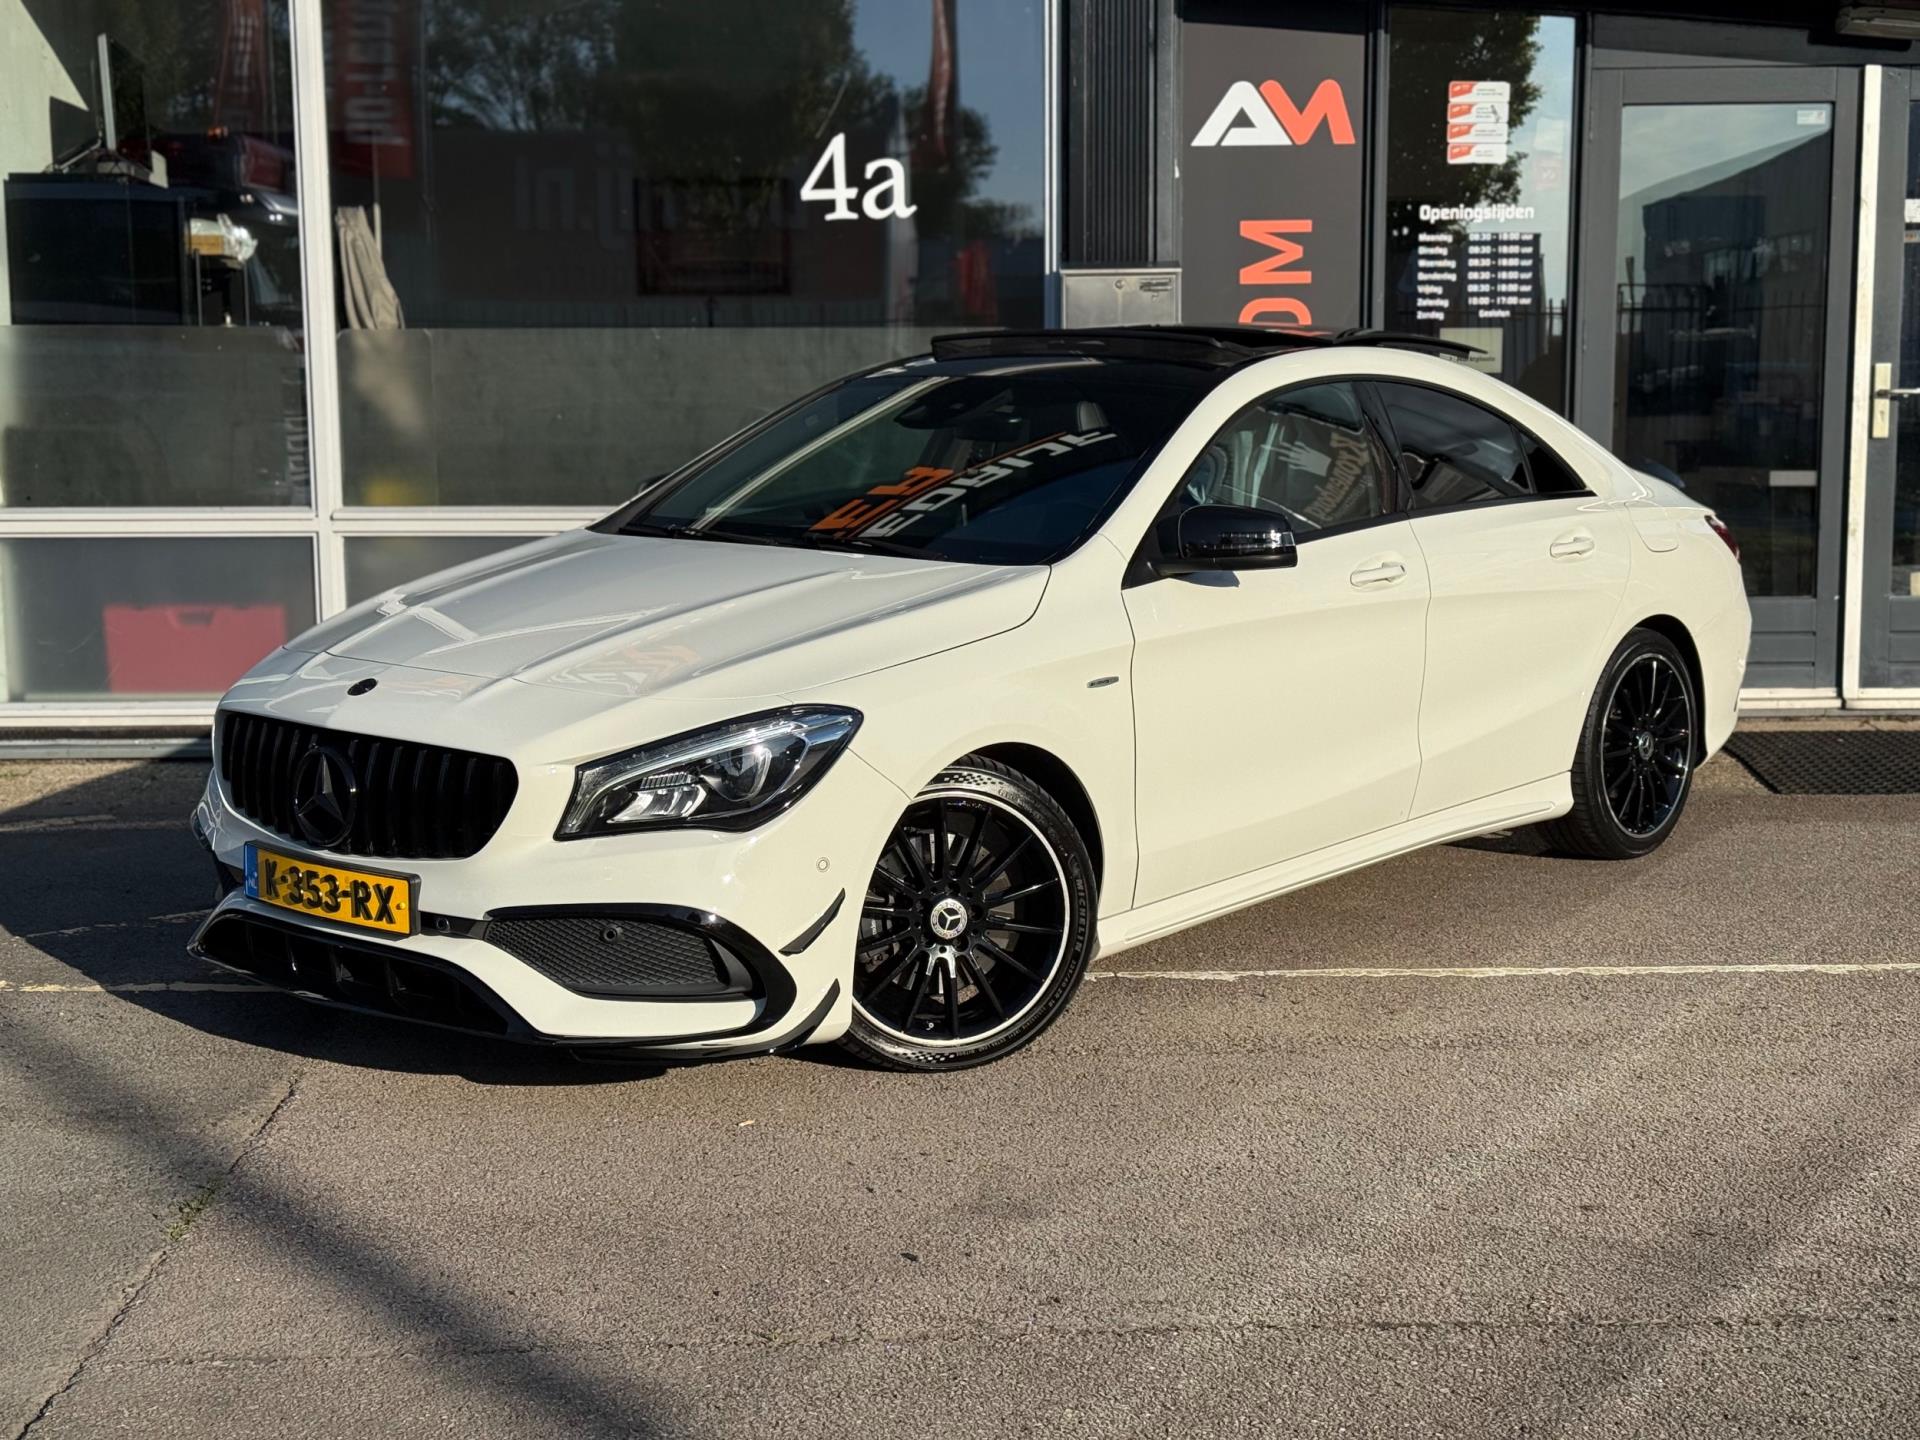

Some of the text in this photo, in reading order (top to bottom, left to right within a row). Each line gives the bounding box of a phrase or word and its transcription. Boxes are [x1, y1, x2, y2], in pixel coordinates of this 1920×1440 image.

[1190, 79, 1356, 147] AM
[800, 132, 918, 221] 4a
[264, 858, 396, 924] K-353-RX
[1073, 878, 1087, 954] MICHELIN
